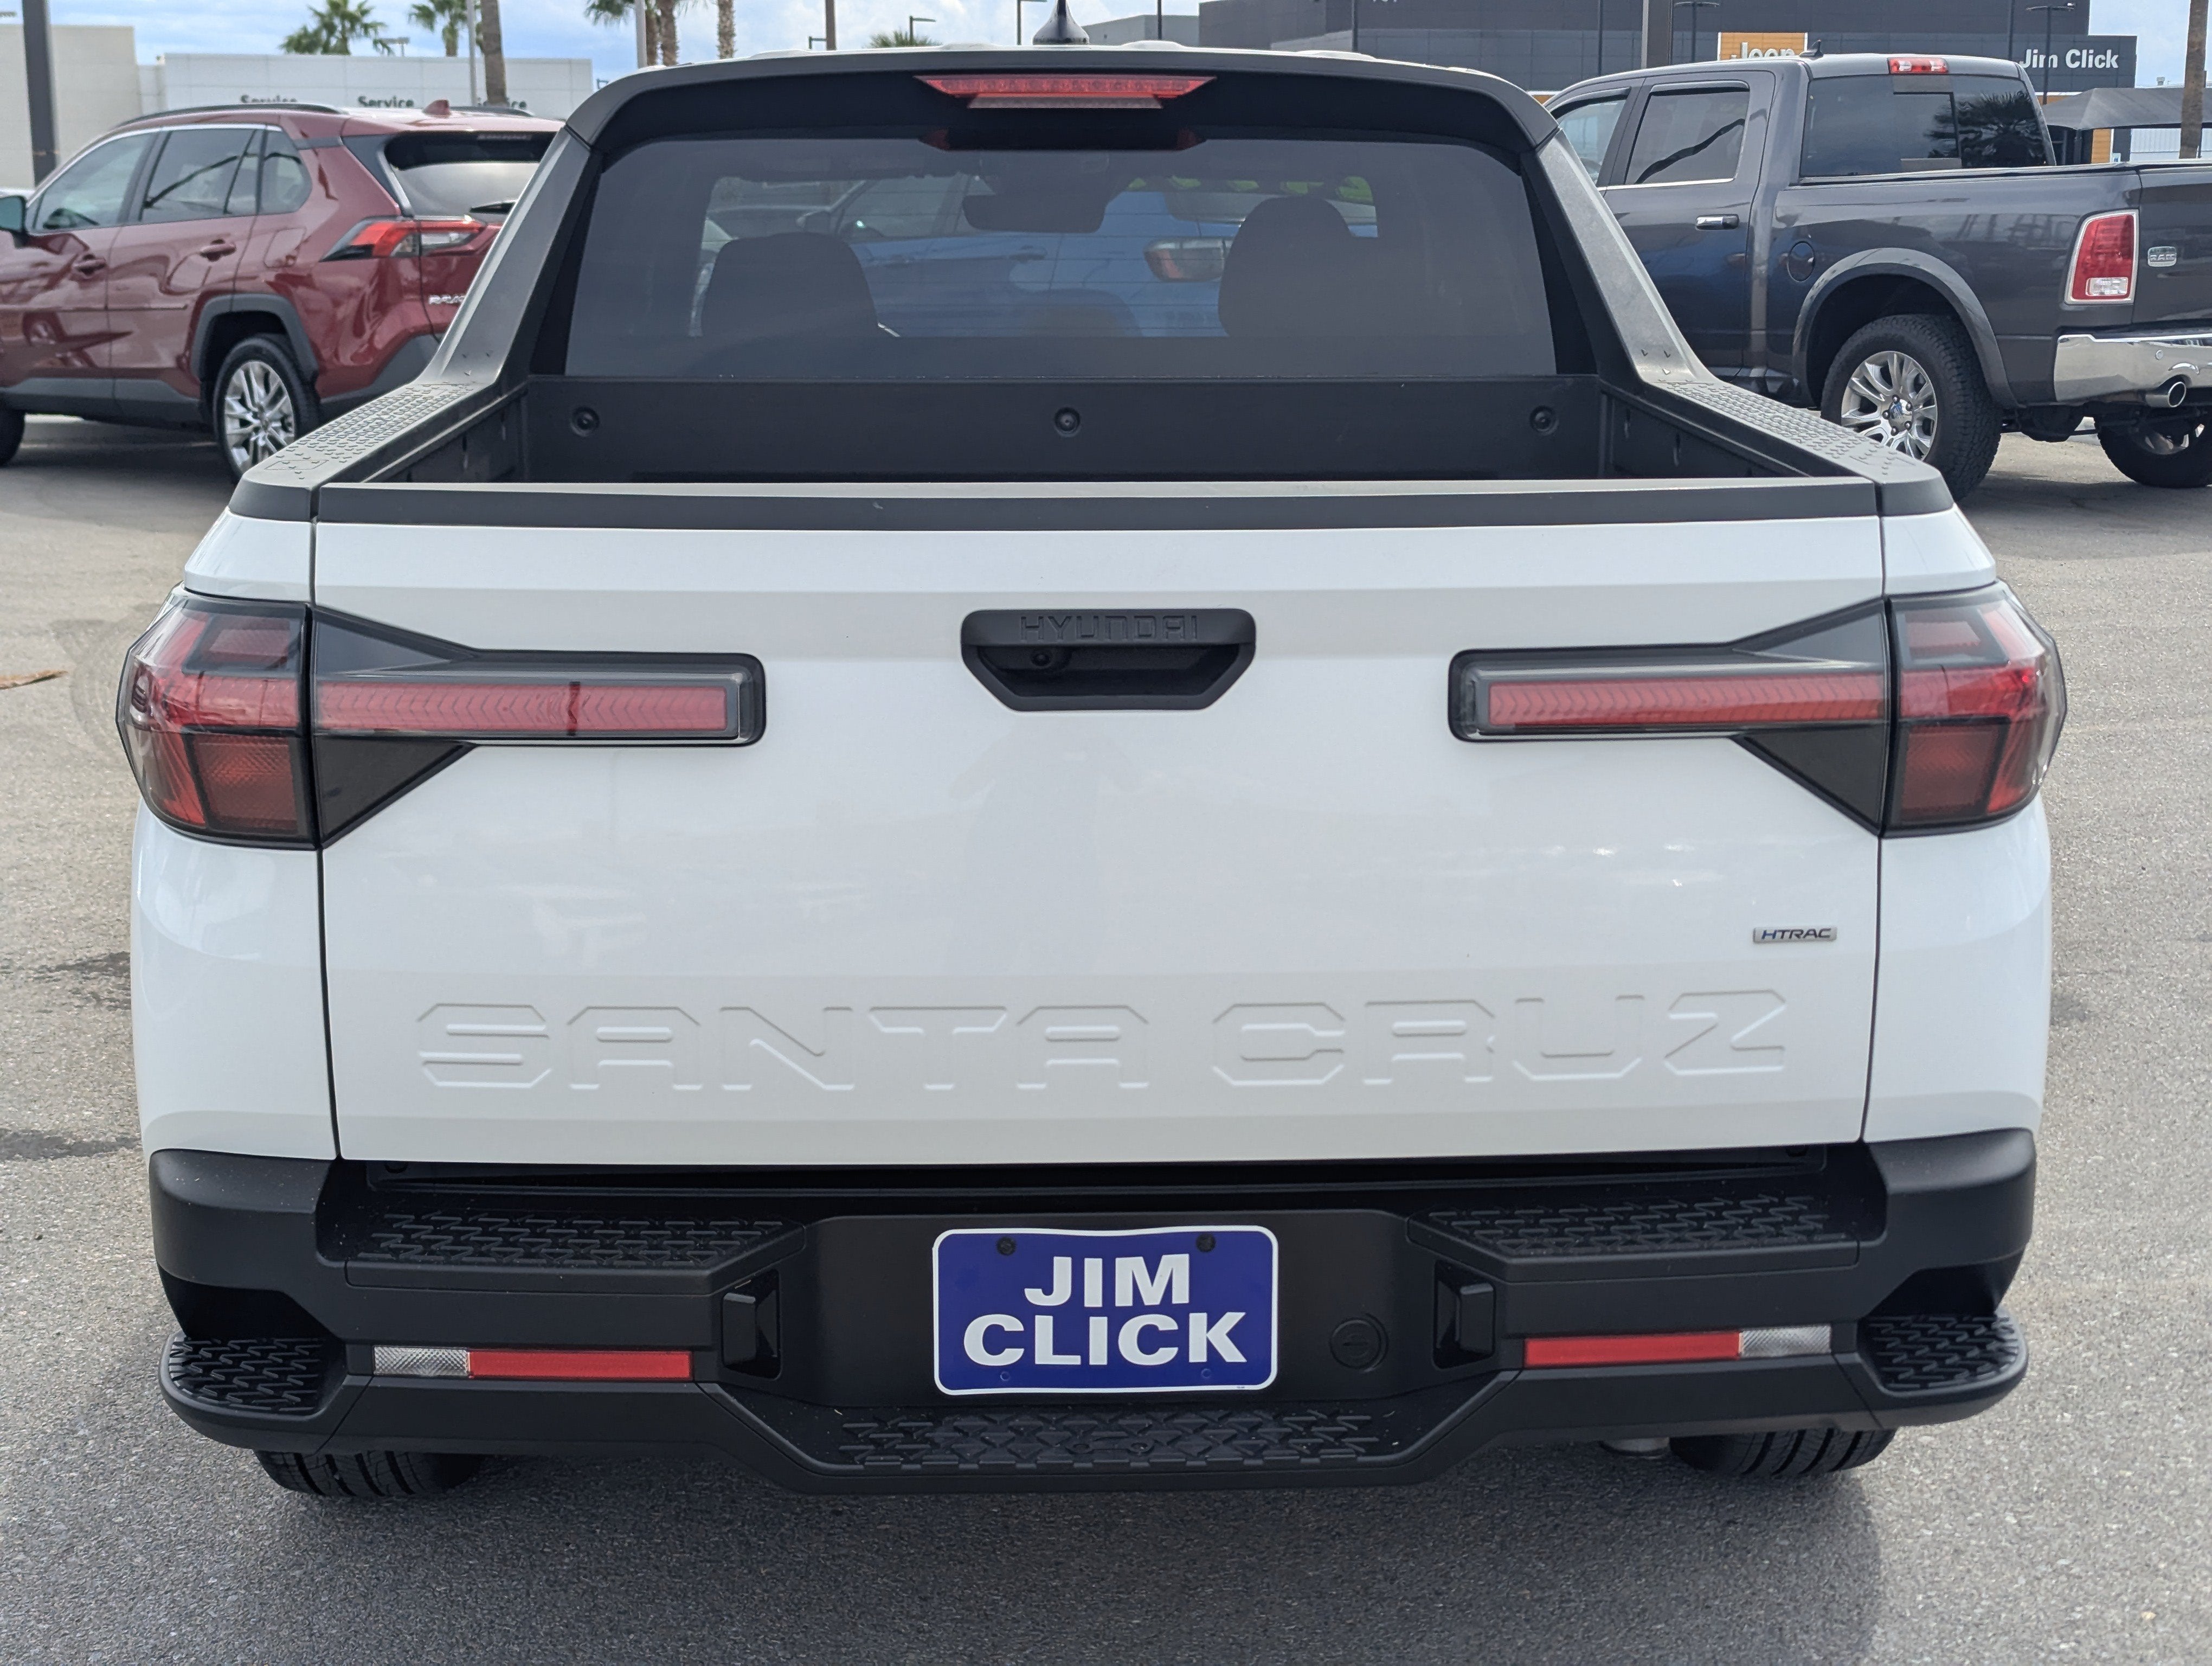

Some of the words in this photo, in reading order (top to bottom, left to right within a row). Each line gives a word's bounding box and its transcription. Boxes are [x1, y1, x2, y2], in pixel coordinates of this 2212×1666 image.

[2019, 49, 2058, 69] Jim
[2066, 49, 2119, 69] Click
[357, 96, 414, 108] Service
[1020, 614, 1198, 641] HYUNDAI
[1761, 928, 1832, 940] HTRAC
[416, 1002, 1149, 1090] SANTA
[1212, 989, 1786, 1086] CRUZ
[1024, 1253, 1190, 1308] JIM
[963, 1311, 1248, 1366] CLICK
